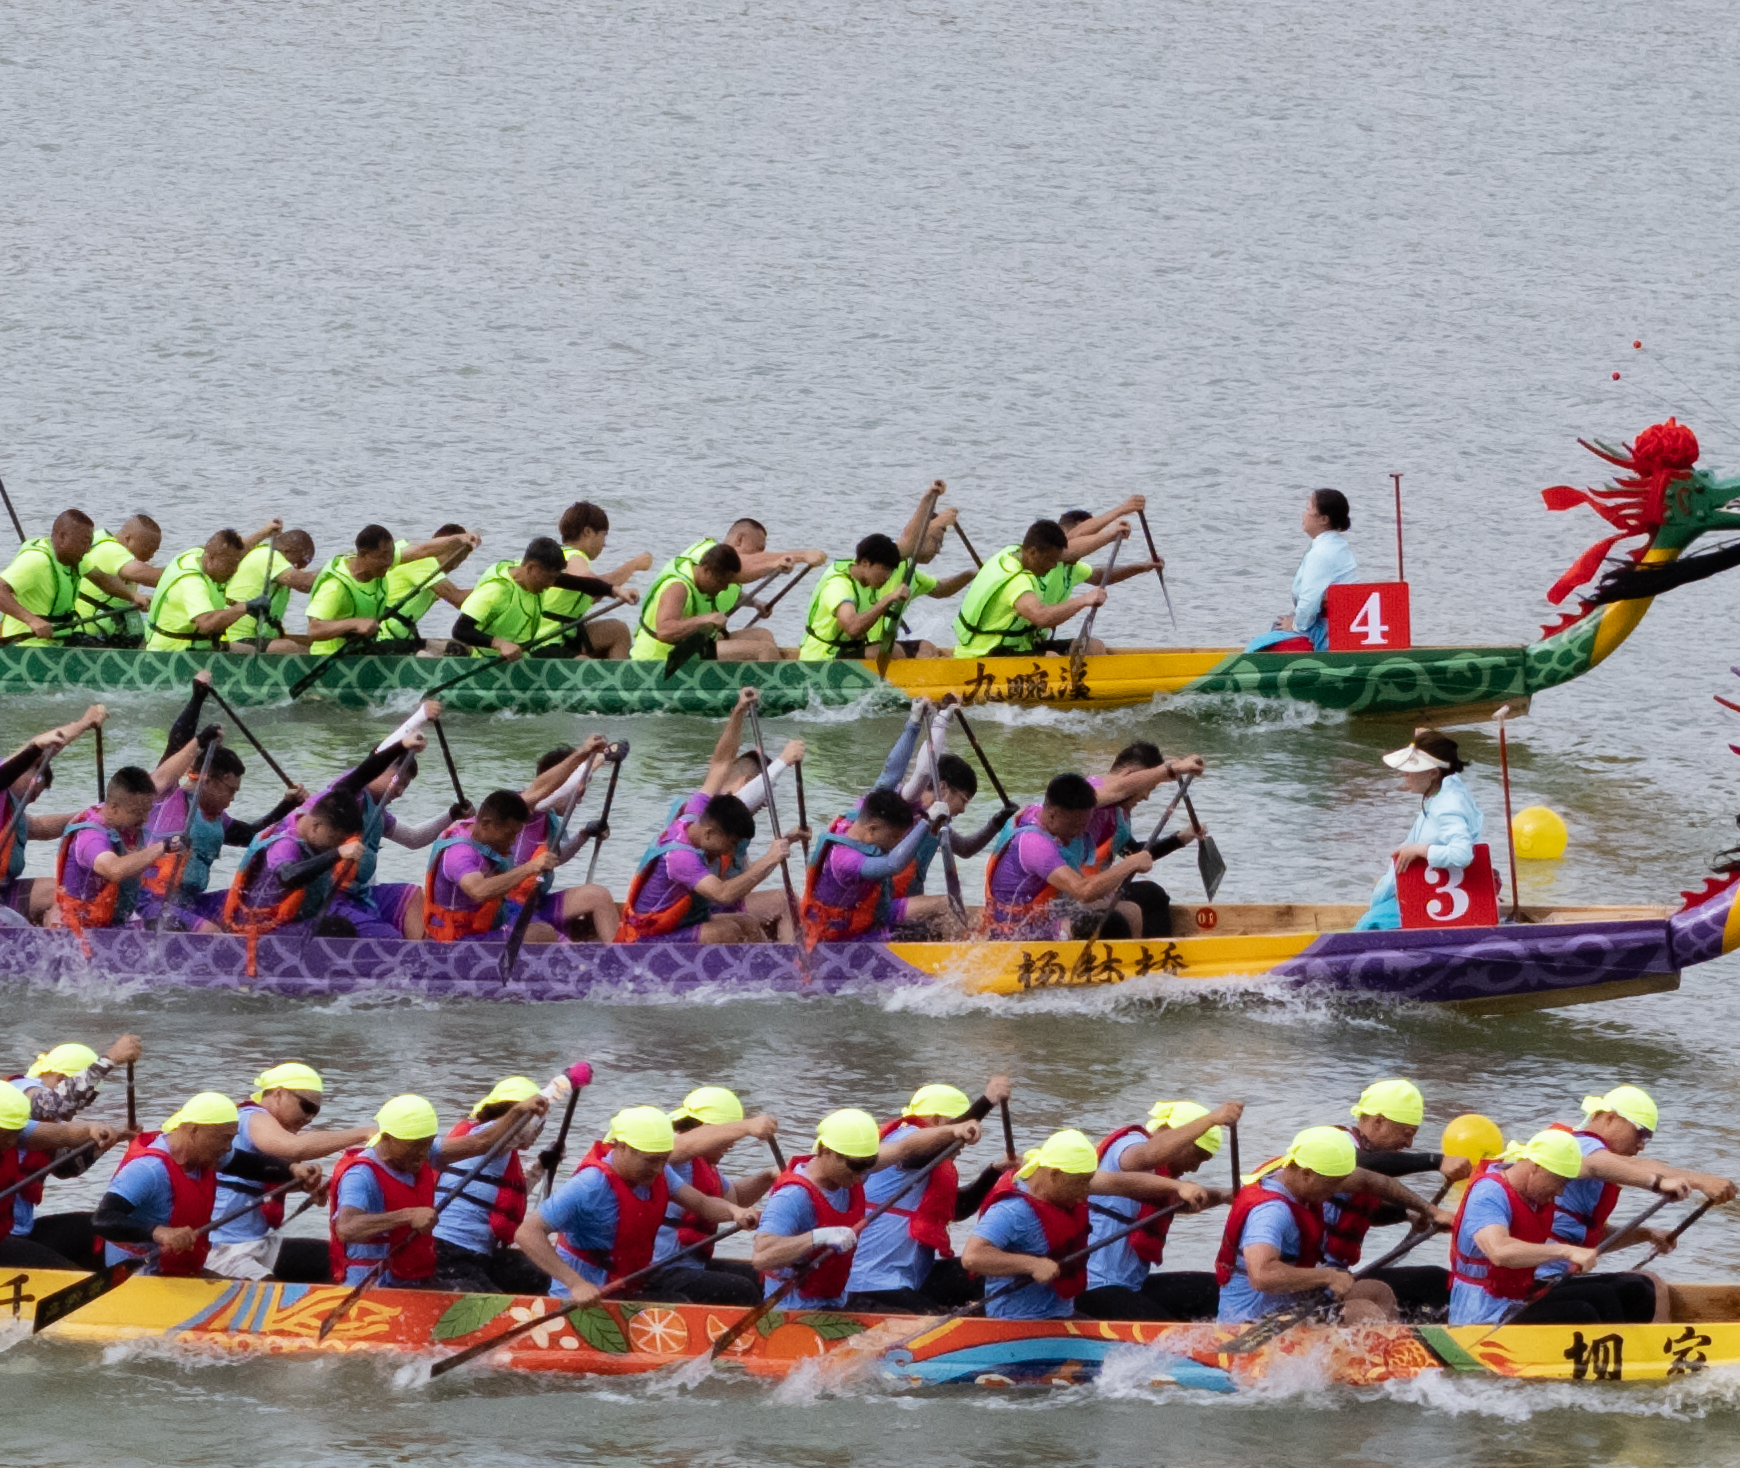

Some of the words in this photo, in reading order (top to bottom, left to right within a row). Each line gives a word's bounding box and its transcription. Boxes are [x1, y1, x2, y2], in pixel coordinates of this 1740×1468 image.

[1348, 592, 1389, 646] 4
[962, 661, 1094, 705] 九畹溪
[1424, 864, 1471, 923] 3
